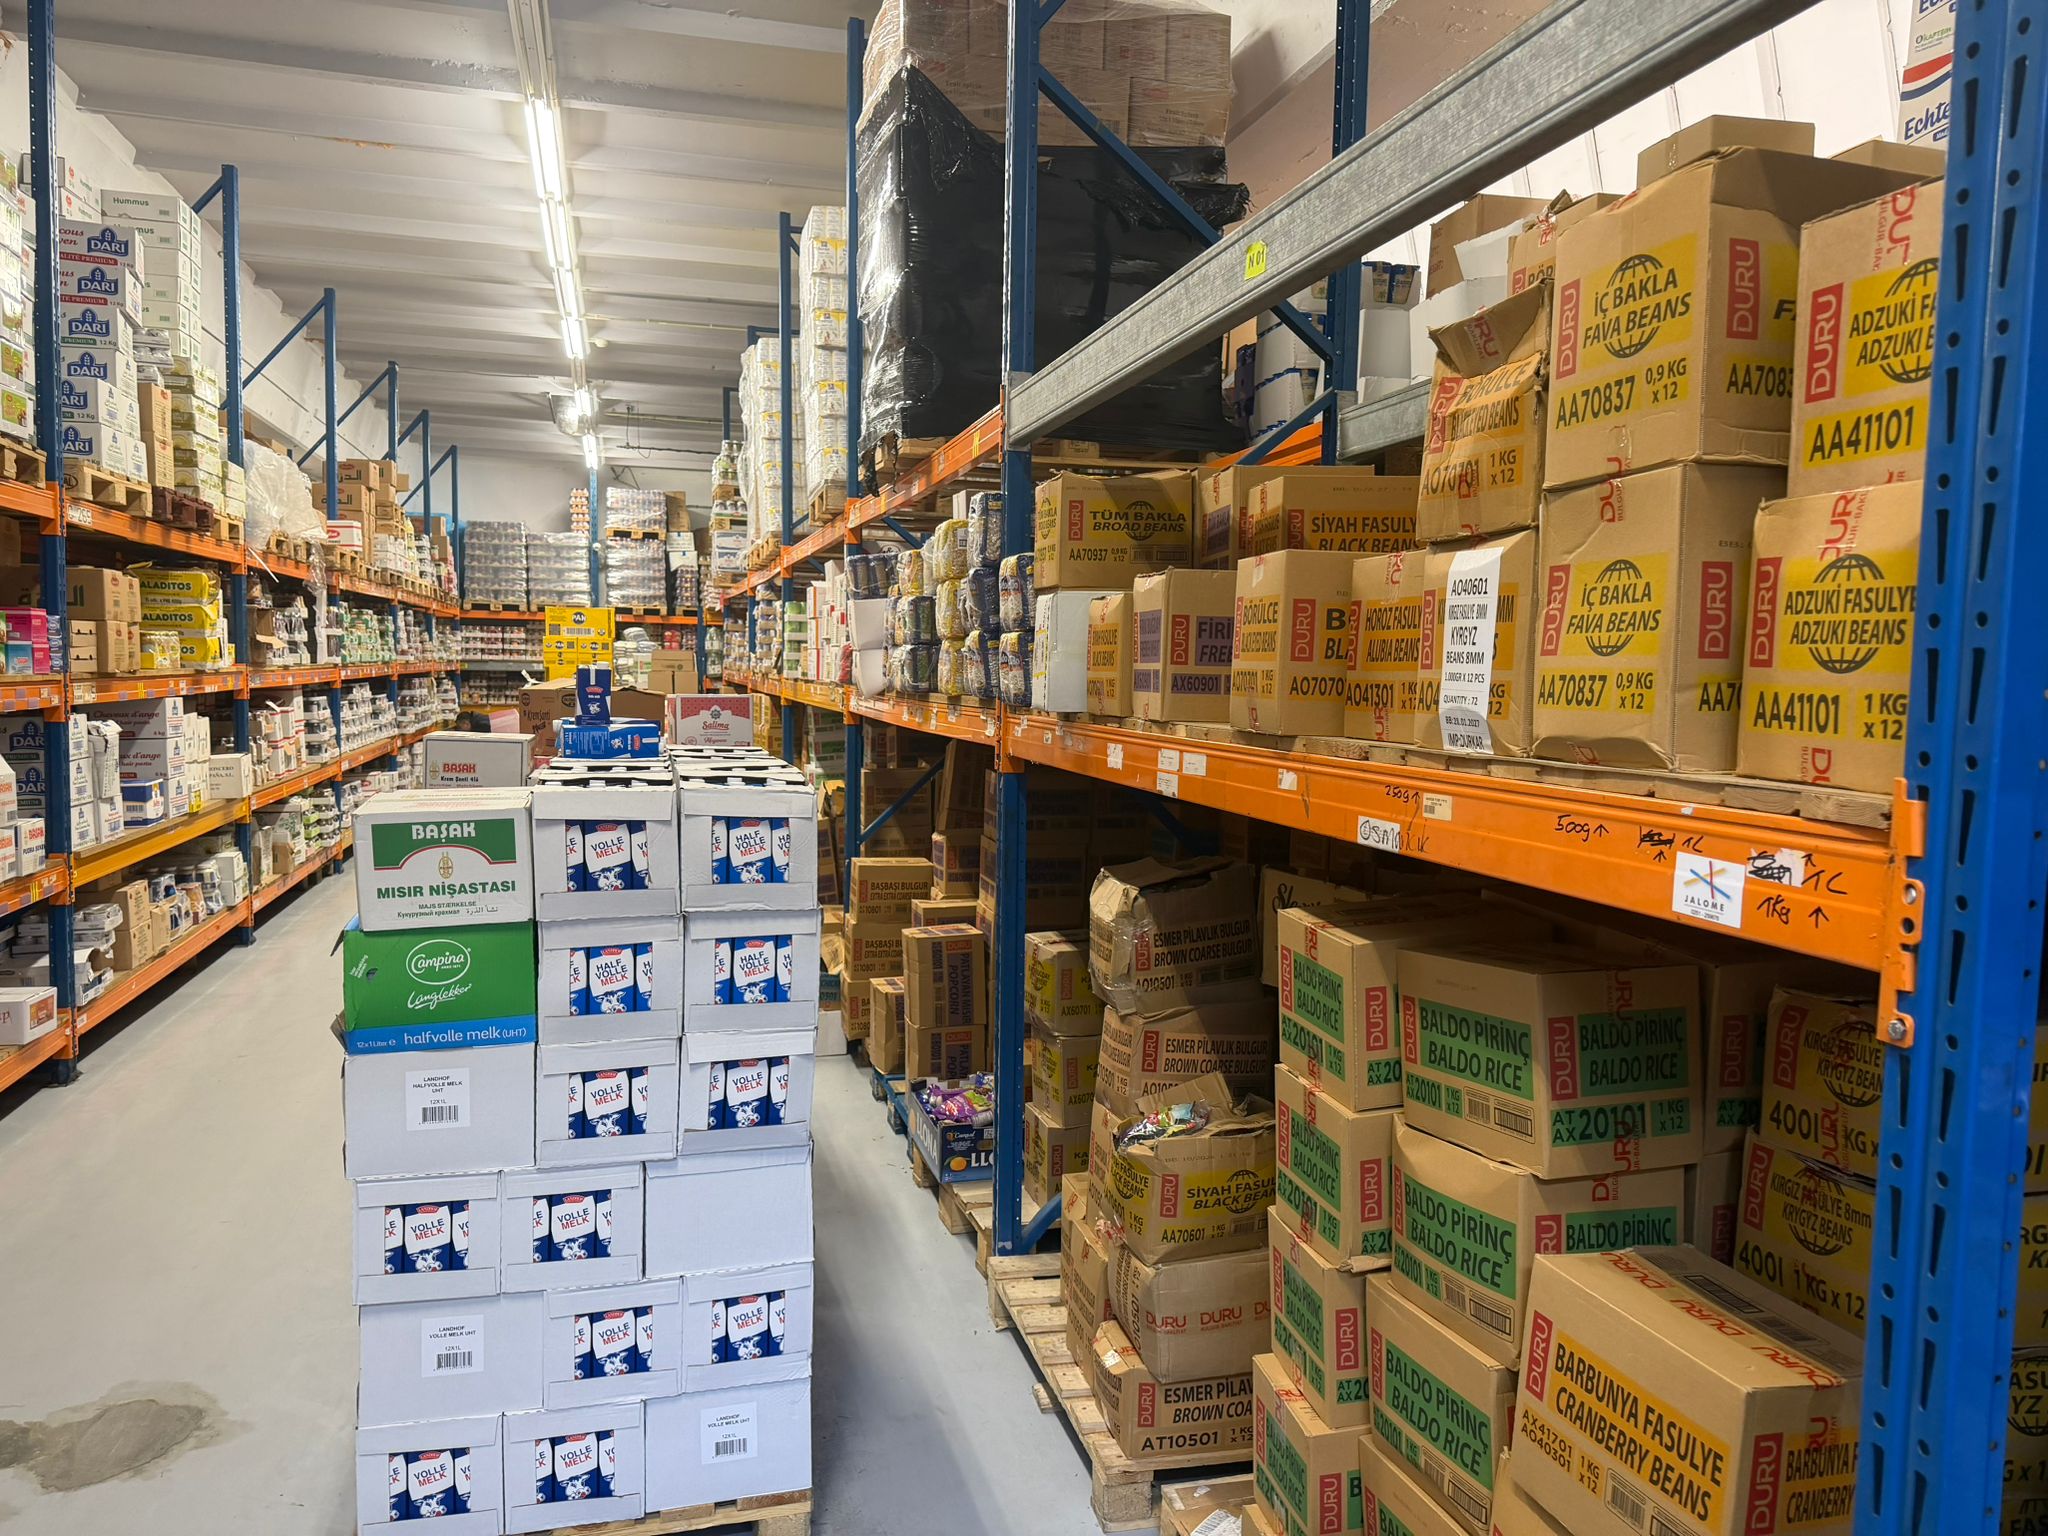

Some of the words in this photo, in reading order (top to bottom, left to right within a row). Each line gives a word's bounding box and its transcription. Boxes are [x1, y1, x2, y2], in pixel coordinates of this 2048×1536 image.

[113, 197, 149, 207] Hummus
[91, 240, 125, 253] DARI
[81, 256, 116, 265] PREMIUM
[81, 280, 115, 292] DARI
[1613, 268, 1678, 309] BAKLA
[1732, 245, 1755, 333] DURU
[1583, 316, 1621, 349] FAVA
[1625, 292, 1692, 334] BEANS
[1849, 291, 1917, 338] ADZUKİ
[71, 322, 106, 334] DARI
[1559, 287, 1577, 372] DURU
[1811, 293, 1836, 395] DURU
[1856, 331, 1921, 367] ADZUKI
[70, 366, 104, 376] DARI
[1667, 357, 1687, 377] KG
[1663, 382, 1678, 400] 12
[61, 395, 84, 407] ARI
[1556, 375, 1635, 429] AA70837
[86, 412, 95, 420] Kg
[1809, 405, 1914, 463] AA41101
[1491, 454, 1496, 467] 1
[1500, 449, 1517, 466] KG
[1500, 467, 1515, 484] 12
[1089, 508, 1130, 521] TÜM
[1135, 511, 1188, 522] BAKLA
[1311, 513, 1357, 533] SİYAH
[1092, 521, 1142, 533] BROAD
[1144, 521, 1185, 533] BEANS
[1319, 538, 1367, 552] BLACK
[1069, 548, 1108, 562] AA70937
[1599, 581, 1651, 607] BAKLA
[1784, 583, 1842, 616] ADZUKİ
[1365, 608, 1393, 631] HOROZ
[1566, 613, 1604, 635] FAVA
[1606, 609, 1661, 633] BEANS
[1173, 618, 1188, 663] DURU
[1451, 626, 1478, 646] KYRGYZ
[1790, 619, 1846, 645] ADZUKI
[1849, 619, 1907, 645] BEANS
[1366, 639, 1391, 662] ALUBIA
[1466, 651, 1485, 664] 8MM
[1171, 676, 1220, 692] AX60901
[1467, 672, 1474, 683] 12
[1474, 673, 1485, 684] PCS
[1636, 671, 1653, 690] KG
[1444, 694, 1468, 705] QUANTITY
[1471, 697, 1478, 706] 72
[1538, 674, 1608, 707] AA70837
[1753, 691, 1841, 735] AA41101
[1864, 693, 1872, 715] 1
[1879, 693, 1908, 716] KG
[1880, 719, 1903, 741] 12
[411, 822, 476, 843] BAŞAK
[736, 830, 760, 844] HALF
[591, 836, 624, 852] VOLLE
[595, 845, 625, 859] MELK
[740, 843, 766, 858] MELK
[377, 885, 423, 899] MISIR
[429, 879, 516, 898] NİŞASTASI
[901, 881, 928, 890] BULGUR
[1684, 895, 1726, 912] JALOME
[1154, 929, 1182, 948] ESMER
[411, 951, 465, 974] Campina
[596, 958, 623, 973] HALF
[740, 951, 765, 965] HALF
[1154, 950, 1187, 967] BROWN
[1189, 947, 1222, 963] COARSE
[600, 973, 629, 987] MELK
[743, 964, 770, 979] MELK
[950, 964, 959, 1015] POPCORN
[404, 1029, 463, 1046] halfvolle
[466, 1027, 501, 1041] melk
[502, 1027, 527, 1038] (UHT)
[1165, 1037, 1198, 1054] ESMER
[1199, 1036, 1235, 1054] PİLAVLIK
[1420, 1006, 1471, 1040] BALDO
[1474, 1015, 1529, 1066] PİRİNÇ
[1163, 1058, 1200, 1074] BROWN
[1203, 1059, 1234, 1074] COARSE
[1428, 1041, 1481, 1078] BALDO
[1485, 1055, 1522, 1092] RICE
[1589, 1057, 1641, 1087] BALDO
[1645, 1053, 1678, 1080] RICE
[412, 1081, 446, 1089] HALFVOLLE
[732, 1072, 764, 1087] VOLLE
[590, 1083, 624, 1100] VOLLE
[1415, 1078, 1442, 1108] 20101
[1551, 1109, 1575, 1126] AT
[1551, 1127, 1577, 1144] AX
[1187, 1183, 1233, 1199] SİYAH
[1193, 1197, 1241, 1210] BLACK
[1405, 1174, 1448, 1229] BALDO
[410, 1218, 444, 1234] VOLLE
[1161, 1228, 1205, 1243] AA70601
[1461, 1248, 1502, 1288] RICE
[1200, 1305, 1242, 1325] DURU
[1164, 1385, 1214, 1404] ESMER
[1173, 1403, 1224, 1424] BROWN
[1555, 1343, 1639, 1429] BARBUNYA
[1644, 1406, 1725, 1488] FASULYE
[1141, 1431, 1219, 1452] AT10501
[1522, 1408, 1574, 1456] AX41701
[1444, 1429, 1482, 1477] RICE
[1556, 1386, 1647, 1474] CRANBERRY
[1650, 1455, 1713, 1522] BEANS
